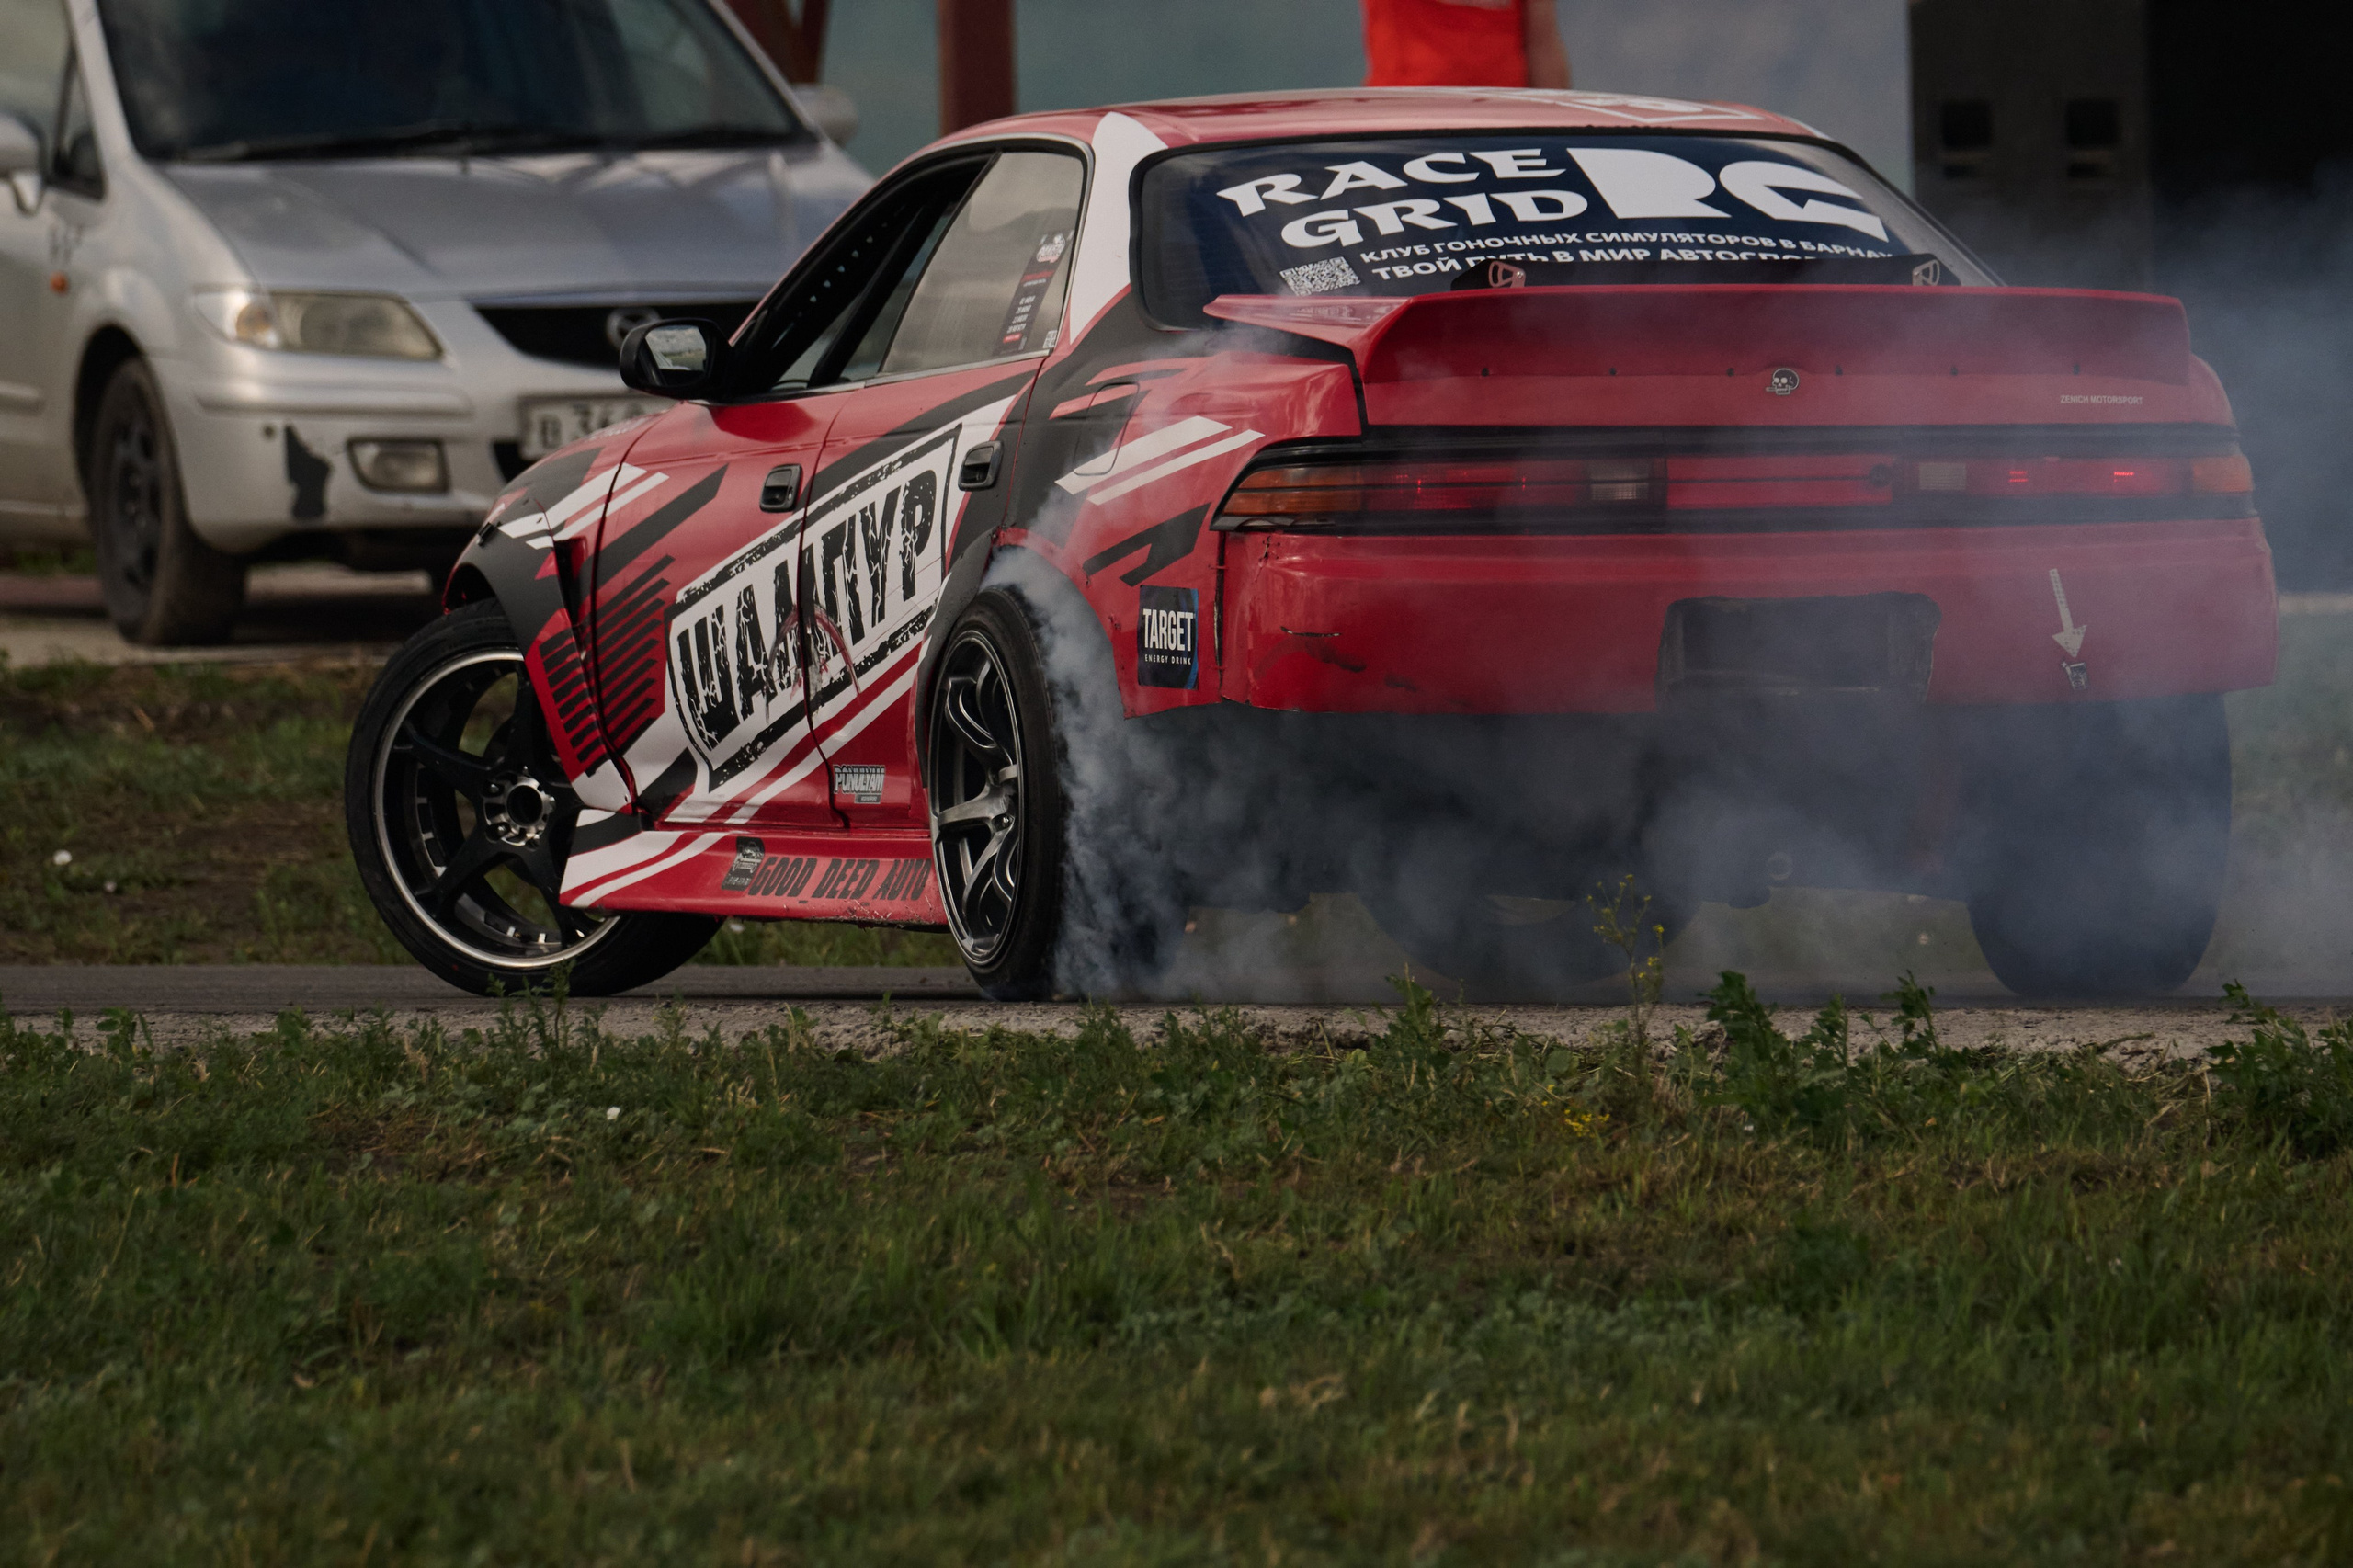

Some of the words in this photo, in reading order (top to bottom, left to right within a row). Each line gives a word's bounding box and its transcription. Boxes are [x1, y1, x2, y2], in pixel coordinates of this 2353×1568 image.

[1216, 148, 1566, 217] RACE
[1281, 189, 1588, 247] GRID
[1360, 244, 1430, 264] КЛУБ
[1434, 232, 1581, 254] ГОНОЧНЫХ
[1586, 232, 1779, 248] СИМУЛЯТОРОВ
[1779, 238, 1796, 249] В
[1371, 256, 1463, 280] ТВОЙ
[1552, 249, 1574, 263] В
[1578, 247, 1651, 262] МИР
[2090, 395, 2143, 405] MOTORSPORT
[1142, 608, 1194, 652] TARGET
[1144, 653, 1169, 664] ENERGY
[1171, 655, 1192, 665] DRINK
[747, 856, 818, 898] GOOD
[811, 858, 881, 901] DEED
[872, 858, 932, 902] AUTO
